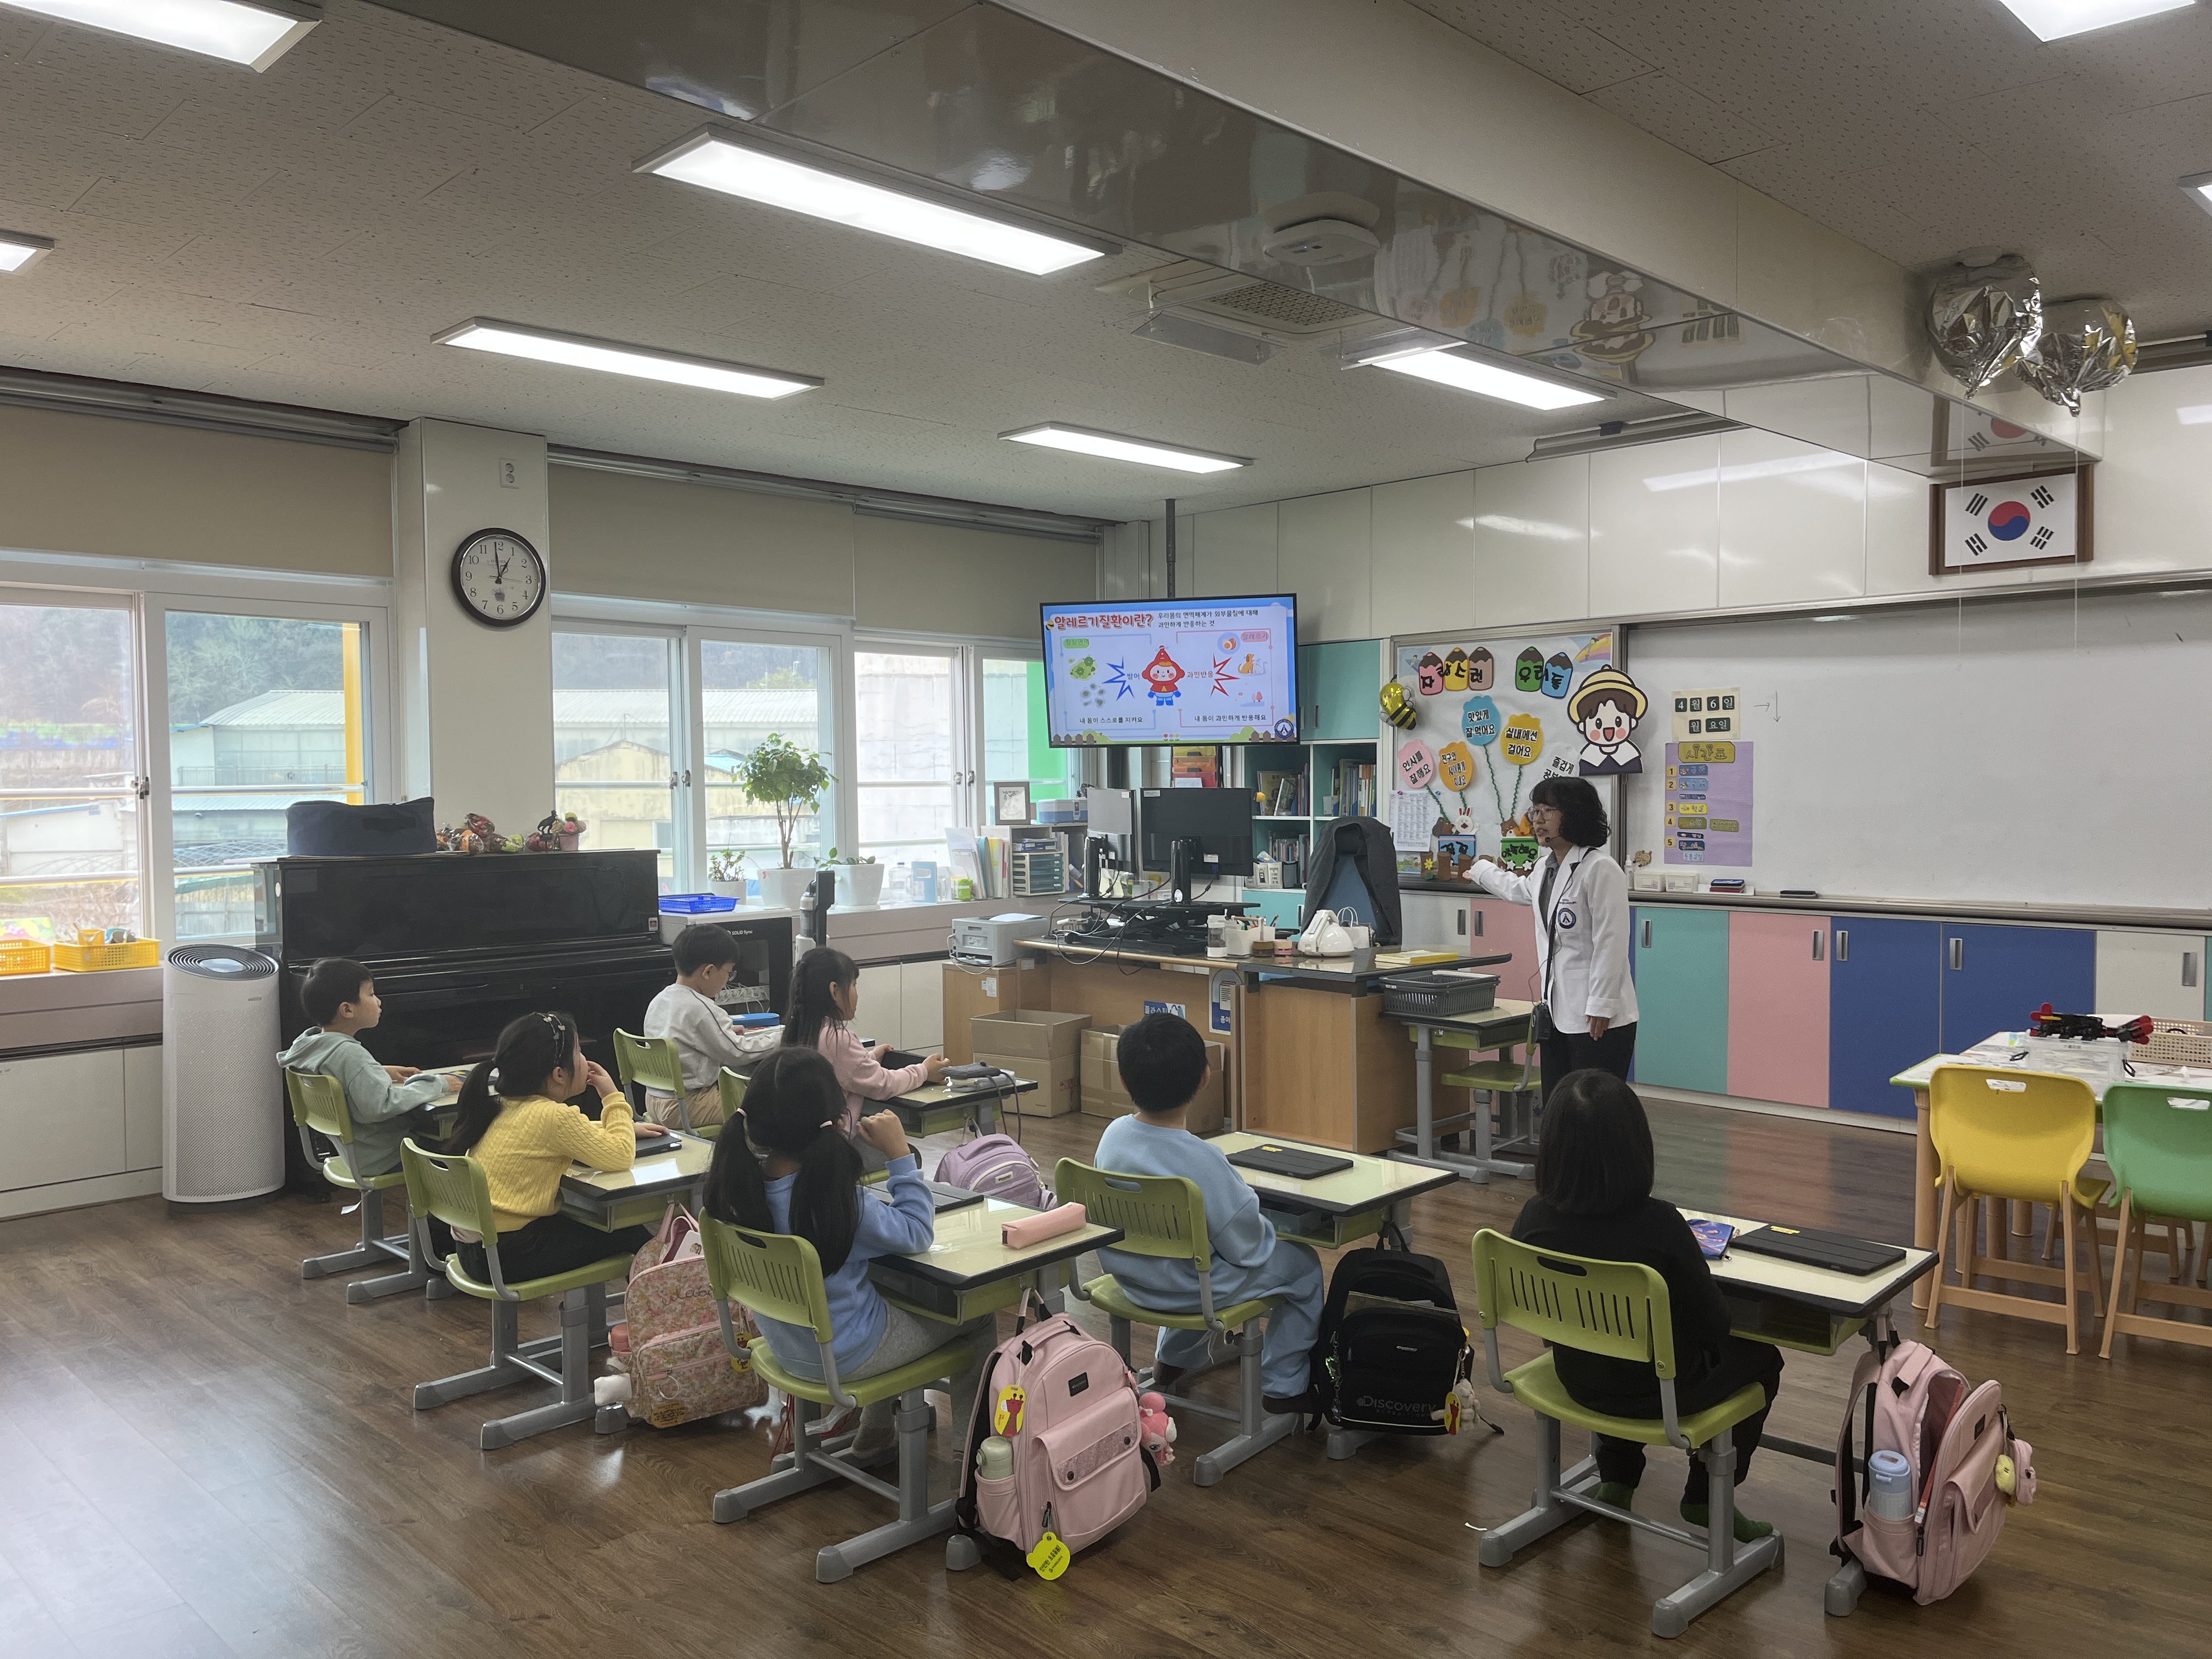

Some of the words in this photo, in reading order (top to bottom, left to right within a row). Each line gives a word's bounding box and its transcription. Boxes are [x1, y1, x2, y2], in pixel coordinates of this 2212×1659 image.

[479, 545, 487, 554] 11
[469, 555, 479, 565] 10
[521, 558, 527, 568] 2
[466, 571, 472, 580] 9
[526, 575, 532, 584] 3
[470, 588, 476, 597] 8
[522, 590, 529, 600] 4
[482, 600, 488, 609] 7
[497, 605, 504, 614] 6
[512, 602, 518, 611] 5
[1054, 614, 1153, 630] 알레르기질환이란?
[1468, 709, 1489, 723] 맛있게
[1505, 727, 1537, 742] 실내에선
[1508, 744, 1531, 757] 걸어요
[1686, 744, 1728, 761] 시간표
[1402, 751, 1423, 771] 인사를
[1552, 756, 1575, 775] 즐겁게
[1220, 1015, 1231, 1024] 종이
